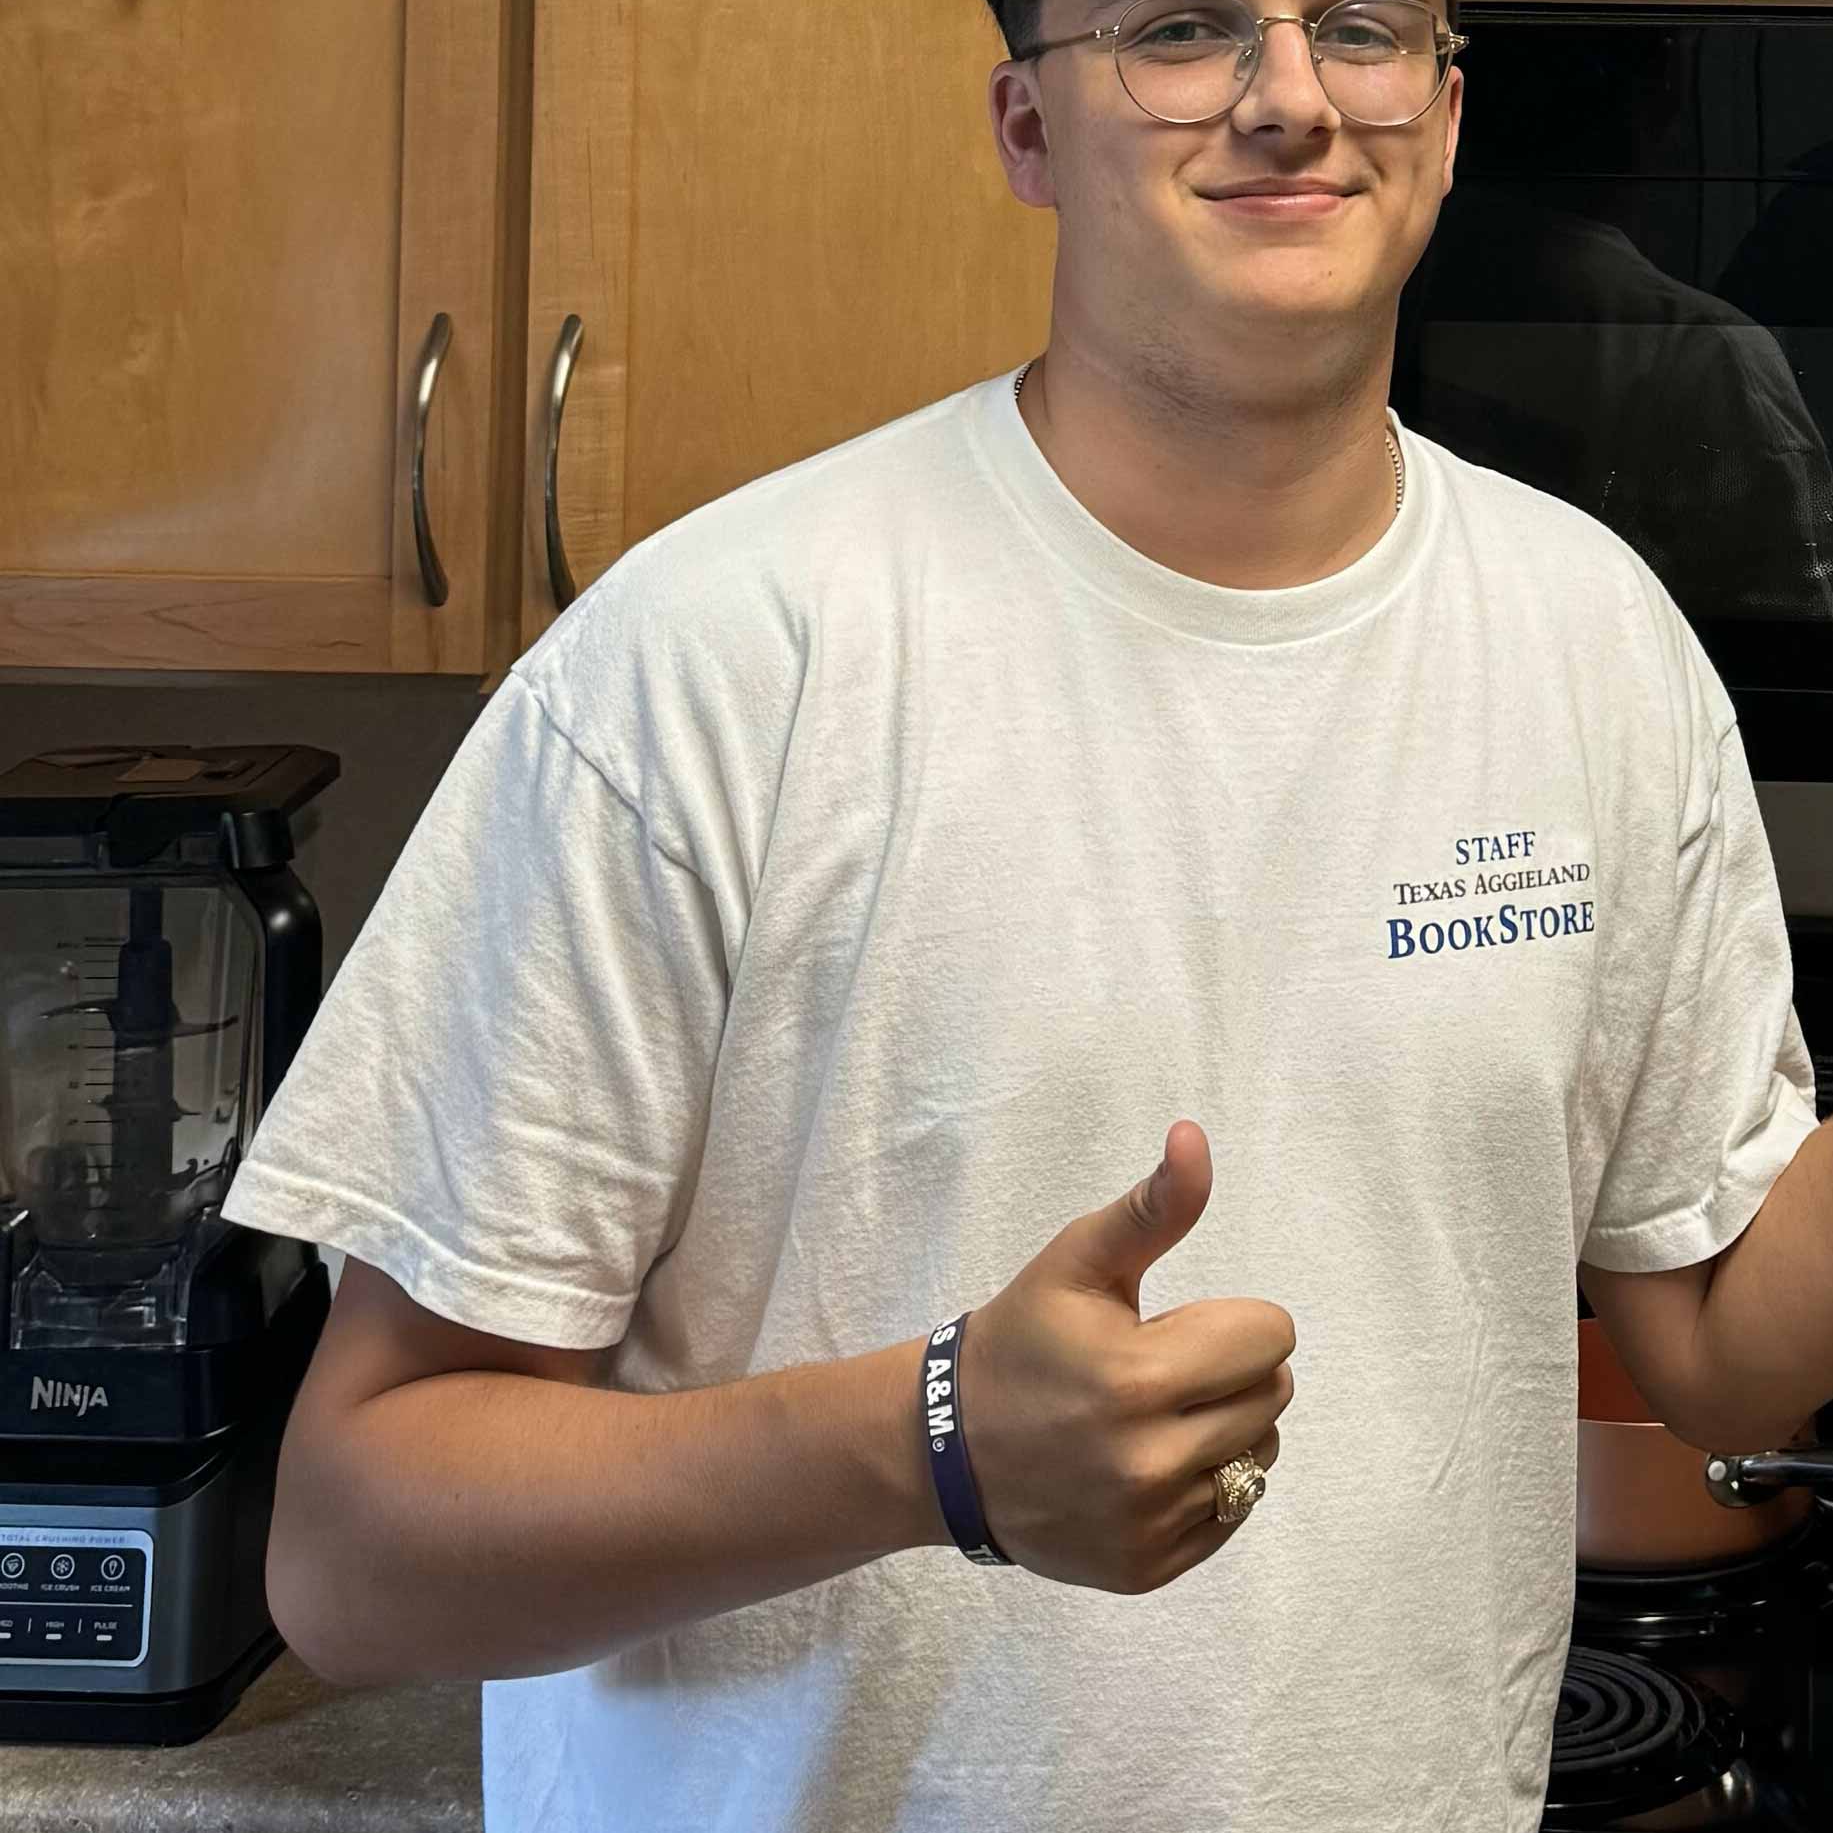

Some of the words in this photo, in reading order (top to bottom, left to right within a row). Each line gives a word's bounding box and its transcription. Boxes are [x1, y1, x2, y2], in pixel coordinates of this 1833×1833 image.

[1456, 831, 1536, 865] STAFF
[1393, 878, 1466, 905] TEXAS
[1474, 863, 1590, 895] AGGIELAND
[30, 1375, 109, 1417] NINJA
